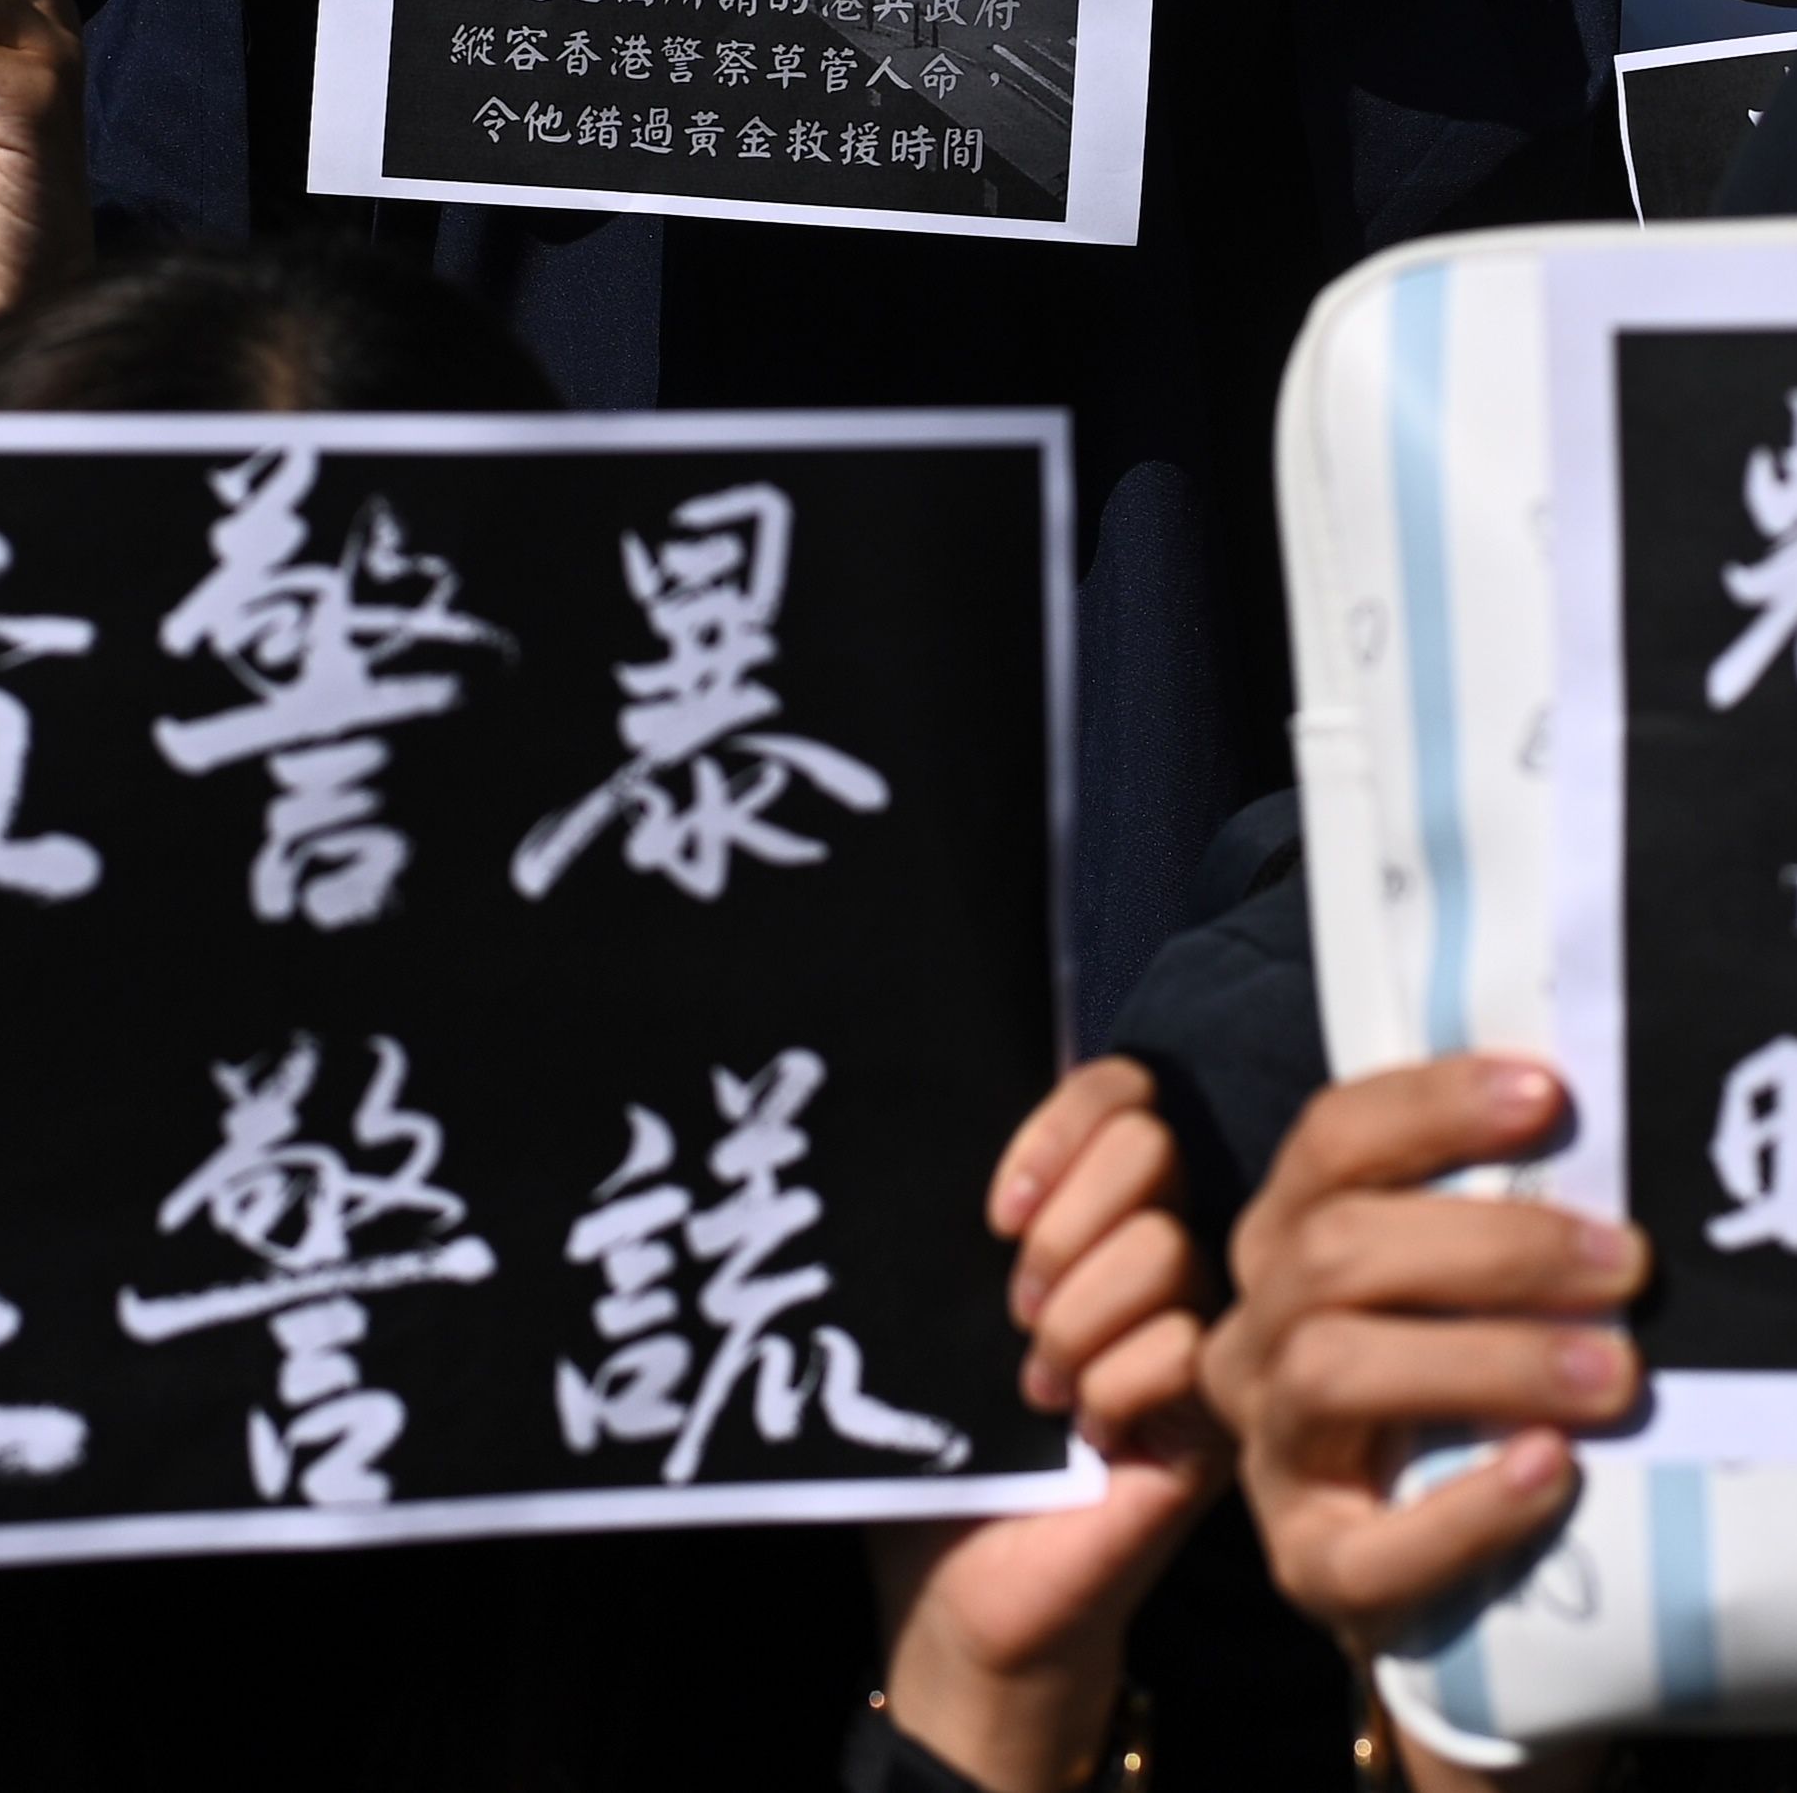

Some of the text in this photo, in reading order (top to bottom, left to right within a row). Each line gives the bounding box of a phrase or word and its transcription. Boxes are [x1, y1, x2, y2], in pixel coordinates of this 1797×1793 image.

[472, 96, 986, 175] 令他錯過黃金救援時間
